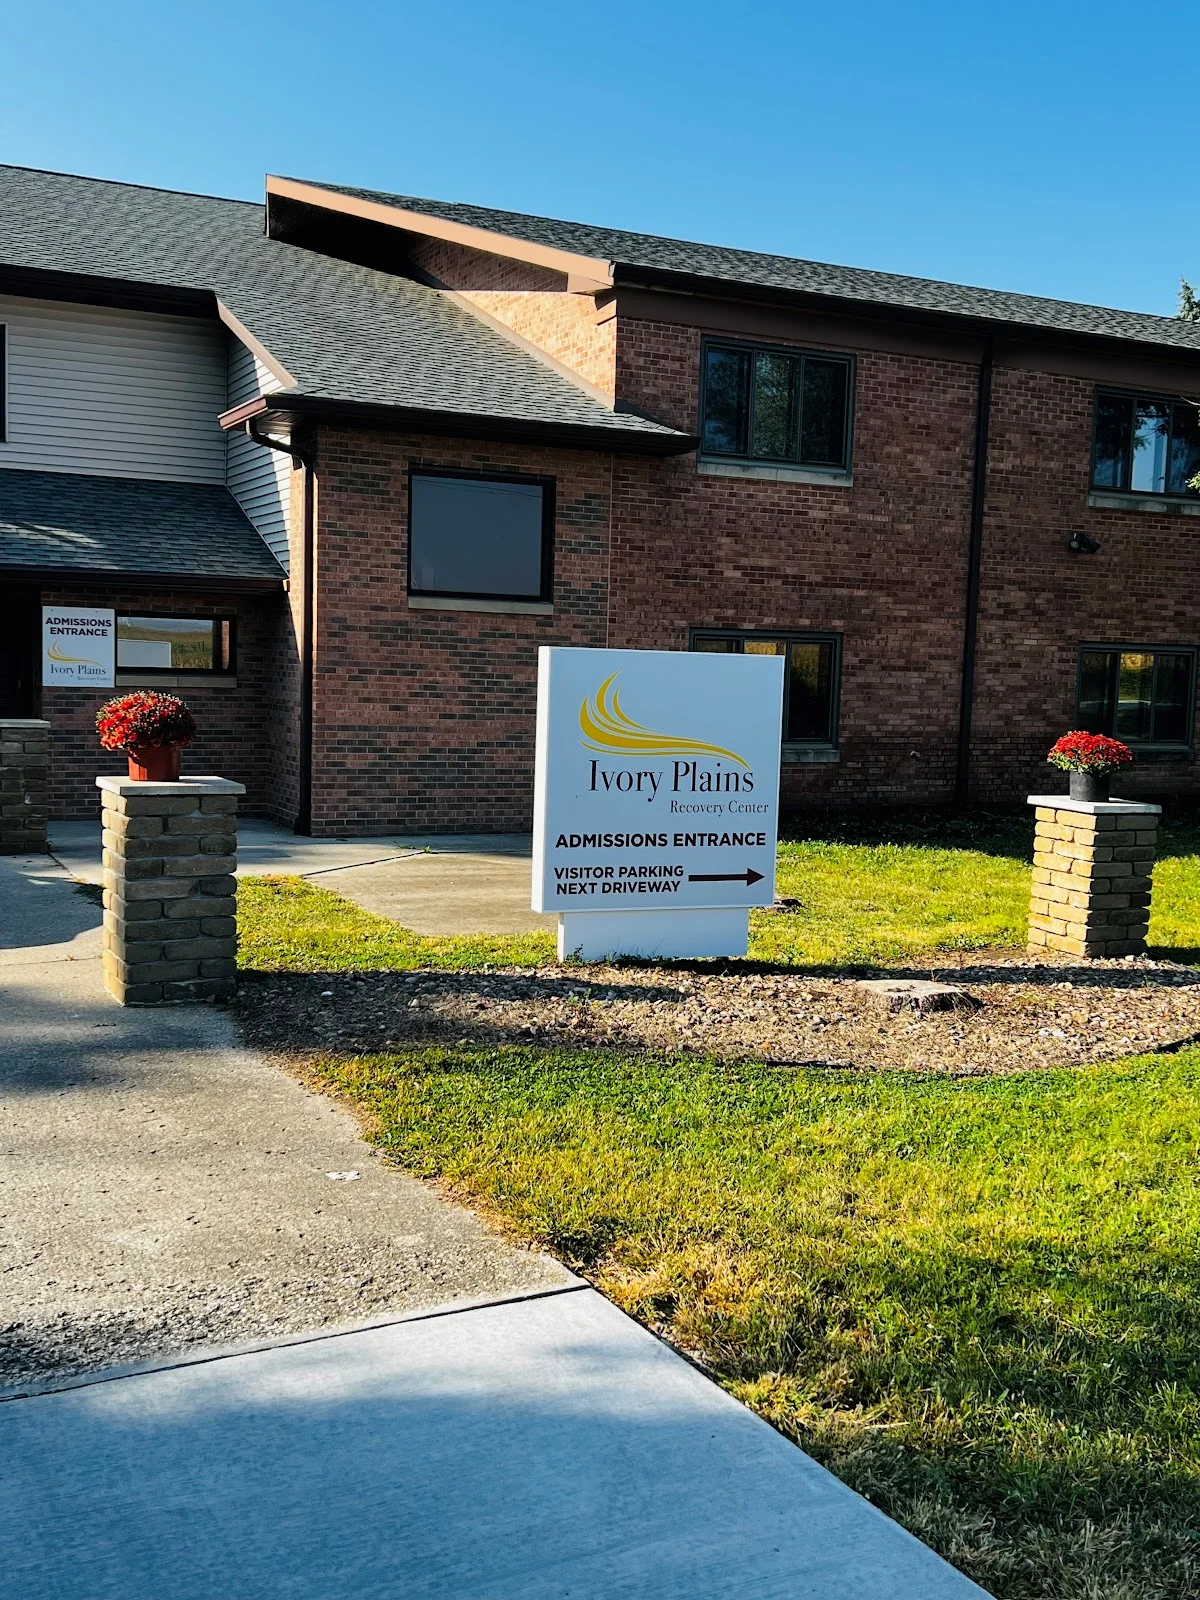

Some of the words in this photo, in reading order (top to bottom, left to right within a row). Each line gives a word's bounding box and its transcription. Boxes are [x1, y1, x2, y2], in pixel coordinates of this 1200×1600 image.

[45, 617, 112, 627] ADMISSIONS
[50, 627, 108, 637] ENTRANCE
[50, 664, 74, 677] Ivory
[77, 664, 106, 675] Plains
[588, 759, 664, 802] Ivory
[670, 760, 754, 793] Plains
[670, 800, 725, 817] Recovery
[728, 800, 769, 814] Center
[555, 833, 668, 848] ADMISSIONS
[673, 832, 766, 847] ENTRANCE
[554, 866, 614, 880] VISITOR
[618, 865, 684, 878] PARKING
[556, 882, 597, 895] NEXT
[601, 880, 681, 894] DRIVEWAY
